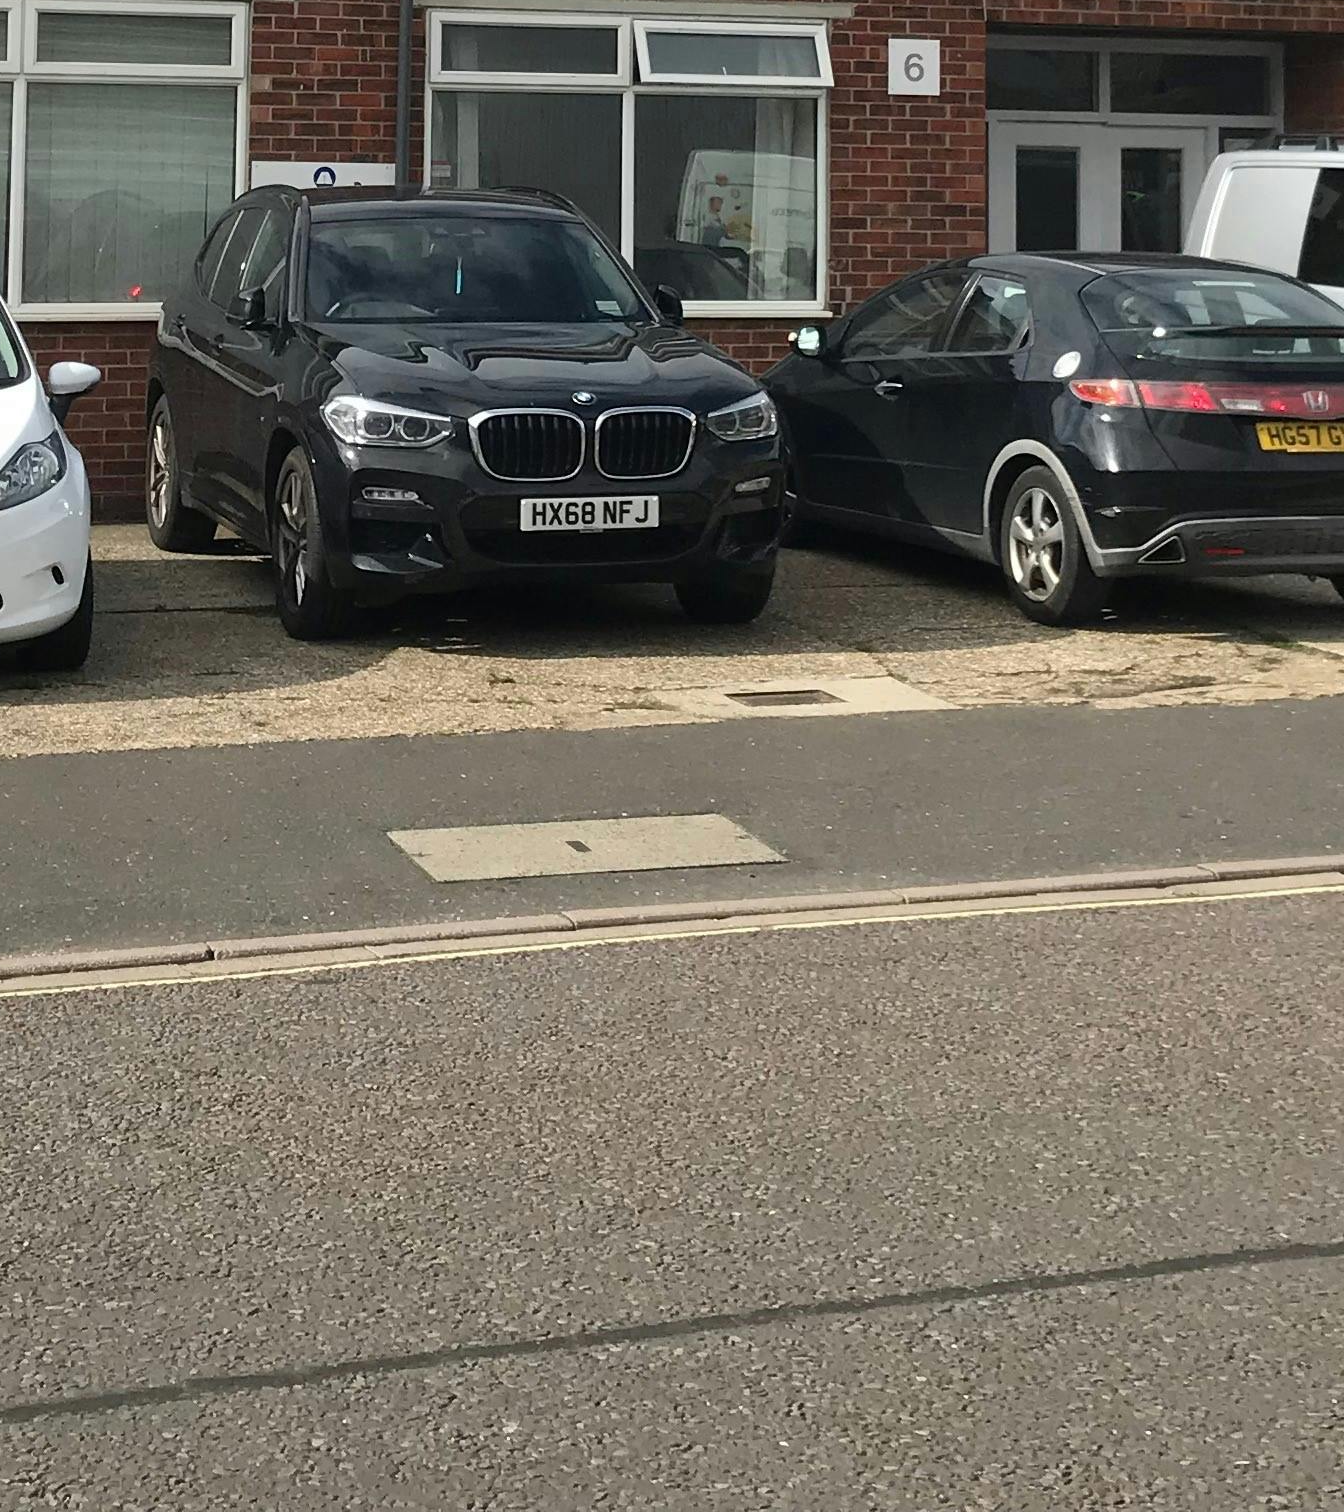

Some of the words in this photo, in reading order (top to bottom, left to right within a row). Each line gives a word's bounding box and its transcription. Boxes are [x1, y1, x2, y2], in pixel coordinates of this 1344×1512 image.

[903, 53, 925, 82] 6
[1266, 425, 1322, 446] HG57
[532, 501, 596, 526] HX68
[603, 500, 649, 524] NFJ
